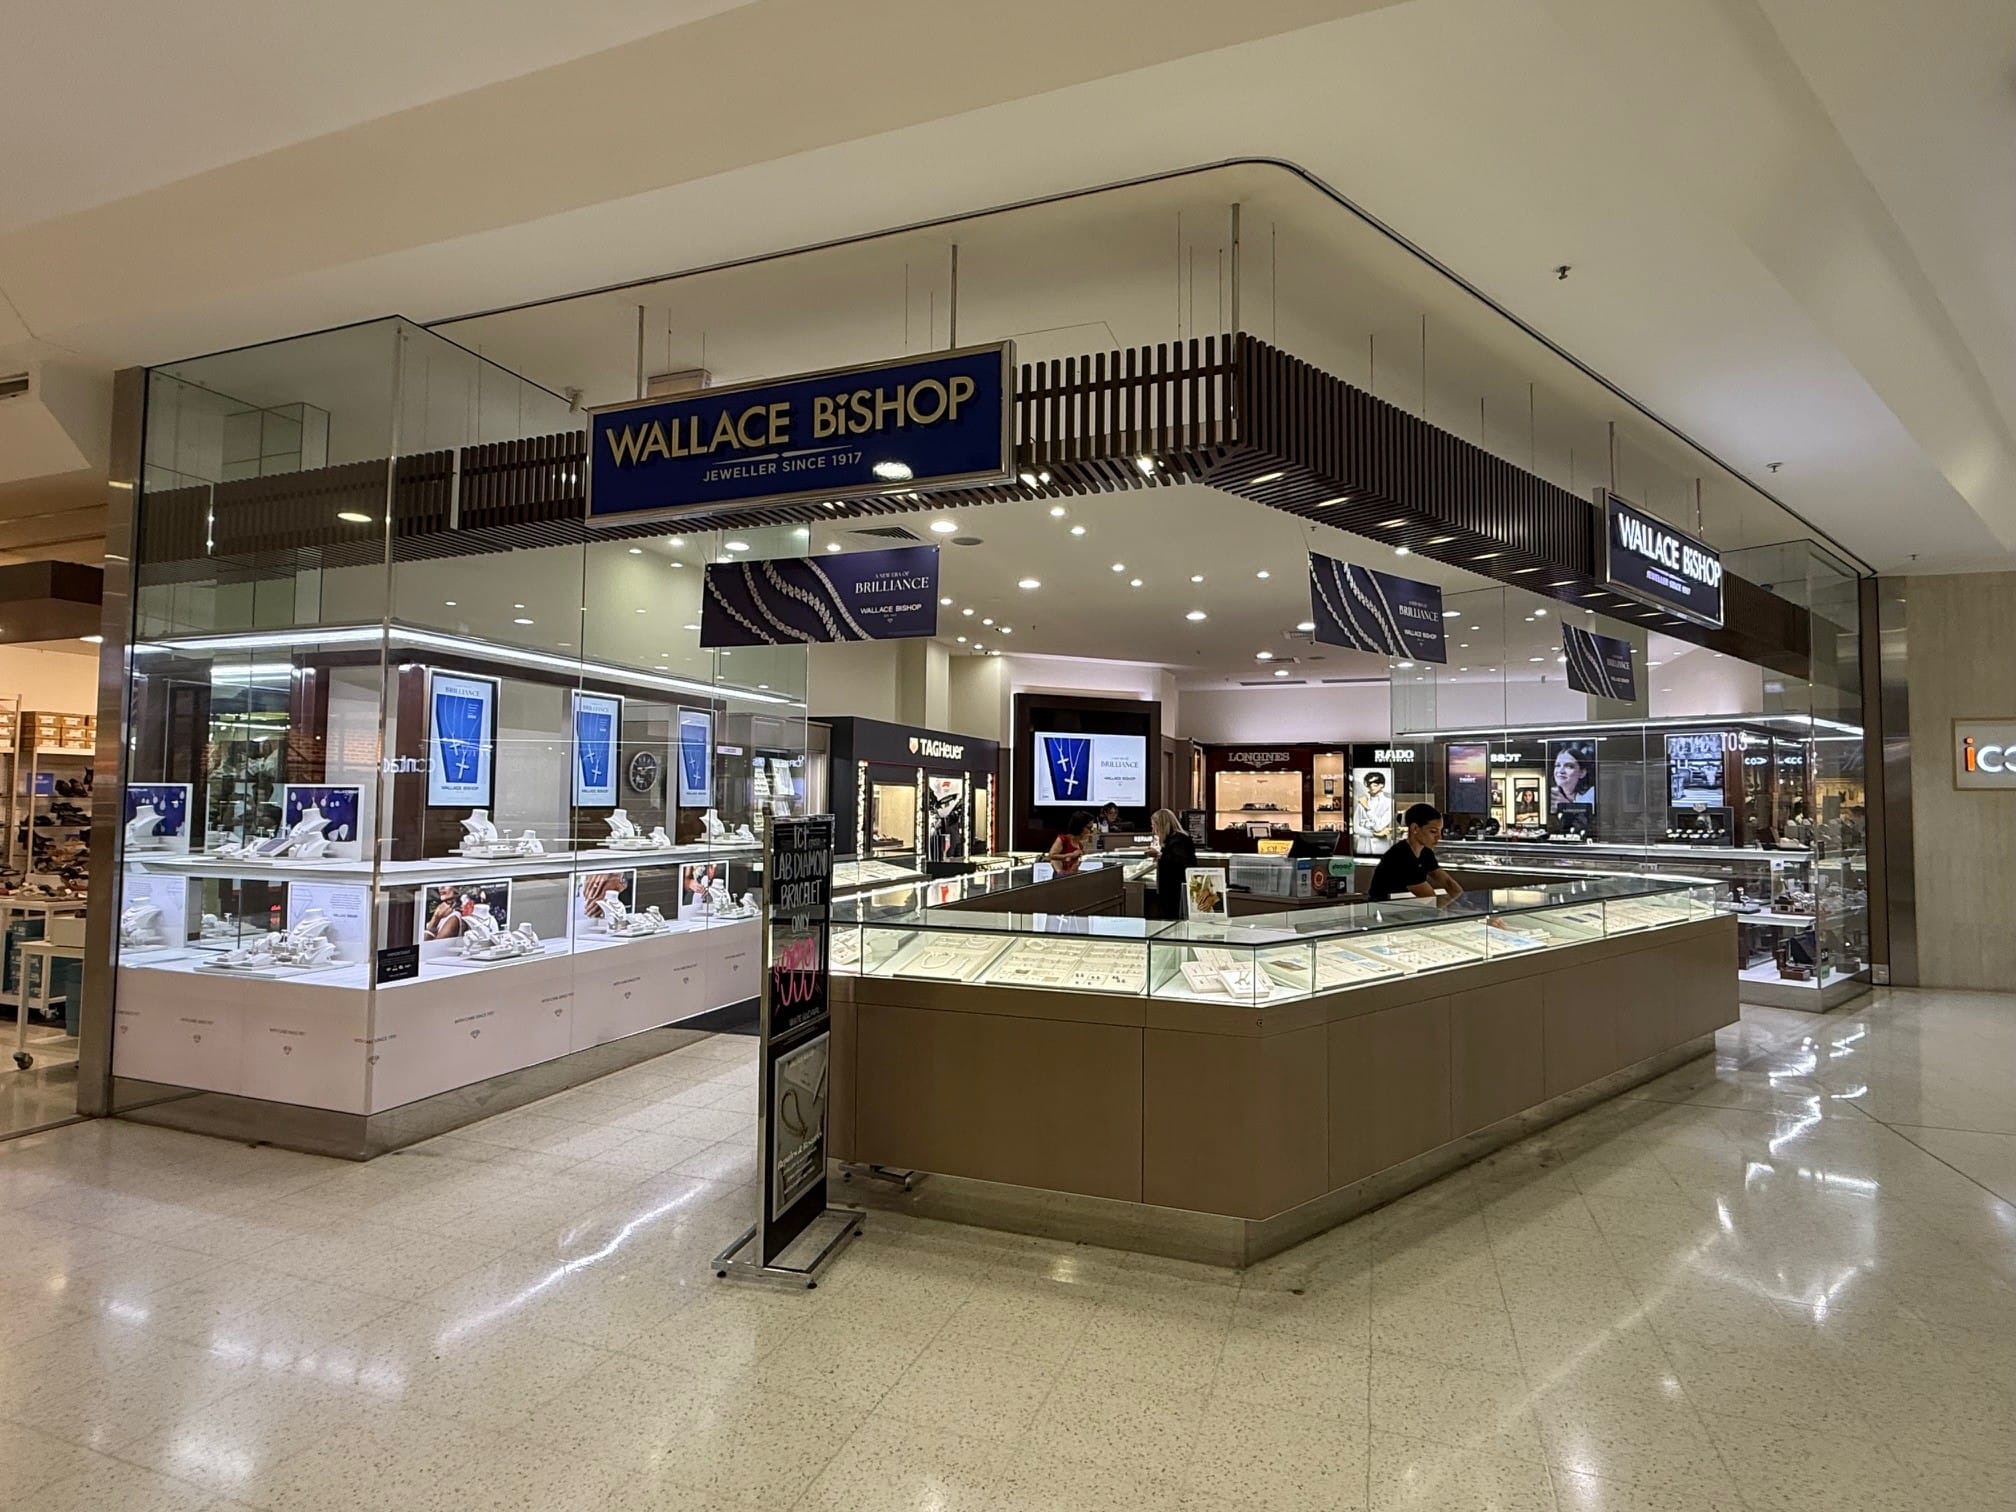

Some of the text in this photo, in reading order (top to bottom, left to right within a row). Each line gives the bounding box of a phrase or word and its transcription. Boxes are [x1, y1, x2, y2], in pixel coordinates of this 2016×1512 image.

[606, 402, 790, 468] WALLACE
[703, 452, 863, 482] JEWELLER SINCE 1917
[1618, 512, 1680, 570] WALLACE
[855, 576, 929, 594] BRILLIANCE
[860, 603, 922, 614] WALLACE BISHOP
[1398, 604, 1440, 622] BRILLIANCE
[445, 686, 481, 697] BRILLIANCE
[1228, 752, 1290, 762] LONGINES
[1374, 749, 1415, 759] RADO
[1100, 760, 1138, 769] BRILLIANCE
[773, 849, 828, 881] LAB DIAMOND
[781, 879, 822, 910] BRACELET
[791, 911, 810, 934] ONLY
